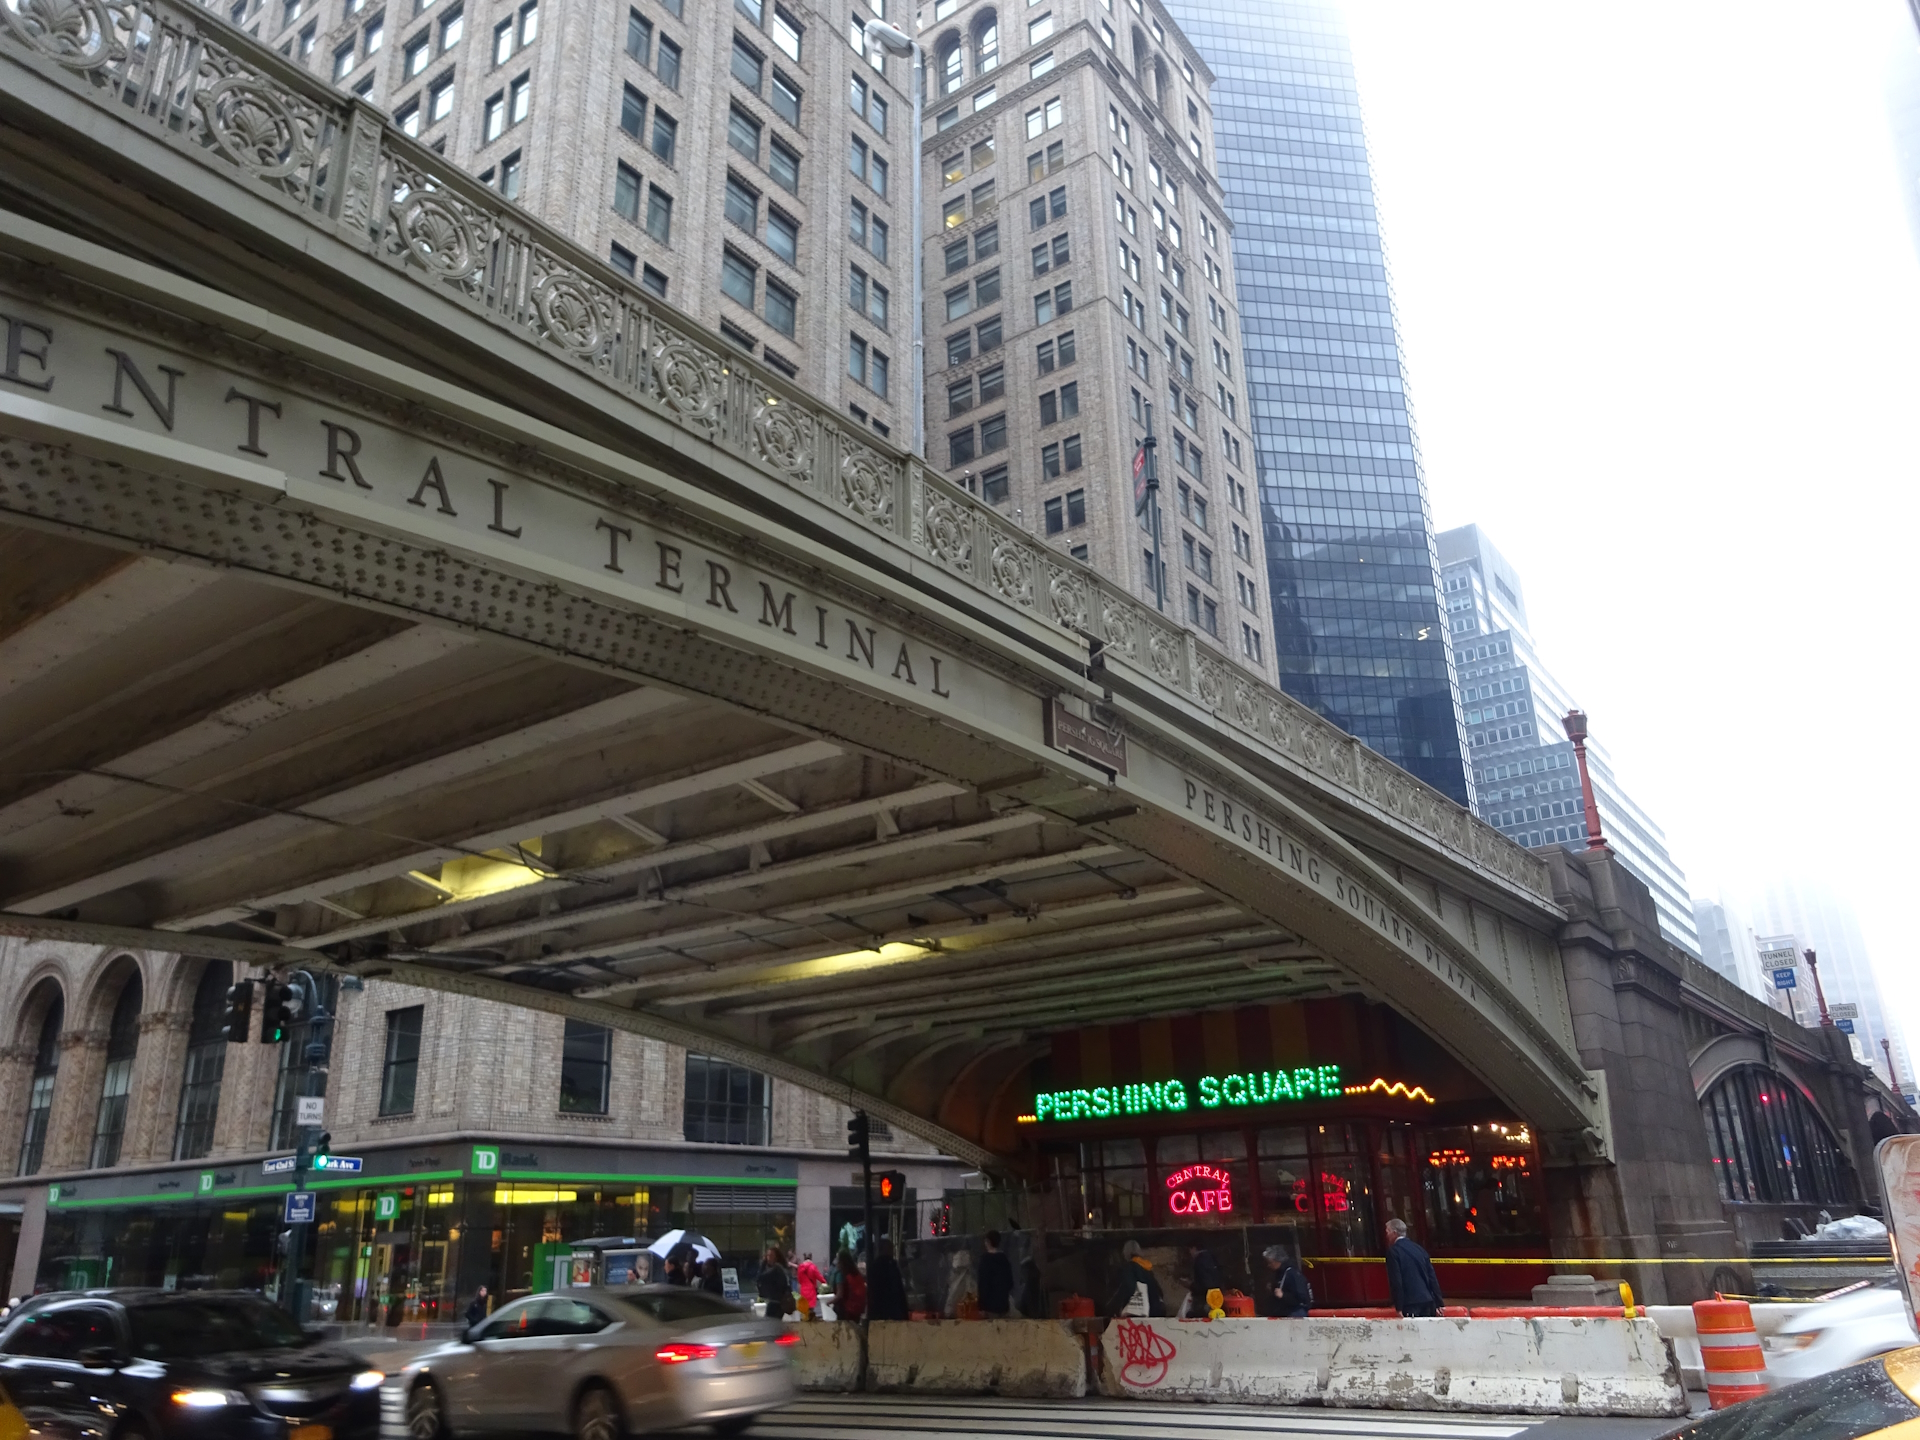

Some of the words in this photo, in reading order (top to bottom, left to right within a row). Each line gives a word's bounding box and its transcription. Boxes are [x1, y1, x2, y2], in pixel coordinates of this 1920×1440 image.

[595, 516, 951, 699] TERMINAL
[1184, 779, 1321, 885] PERSHING
[1763, 951, 1793, 961] TUNNEL
[1765, 958, 1795, 968] CLOSED
[1777, 979, 1794, 987] RIGHT
[1036, 1079, 1188, 1121] PERSHING
[1199, 1065, 1342, 1107] SQUARE
[306, 1102, 317, 1110] NO
[300, 1112, 322, 1120] TURNS
[323, 1160, 338, 1168] ark
[340, 1160, 354, 1169] Ave
[475, 1151, 496, 1169] TD
[501, 1153, 539, 1166] Bank
[201, 1174, 213, 1191] TD
[1166, 1165, 1231, 1189] CENTRAL
[379, 1197, 395, 1216] TD
